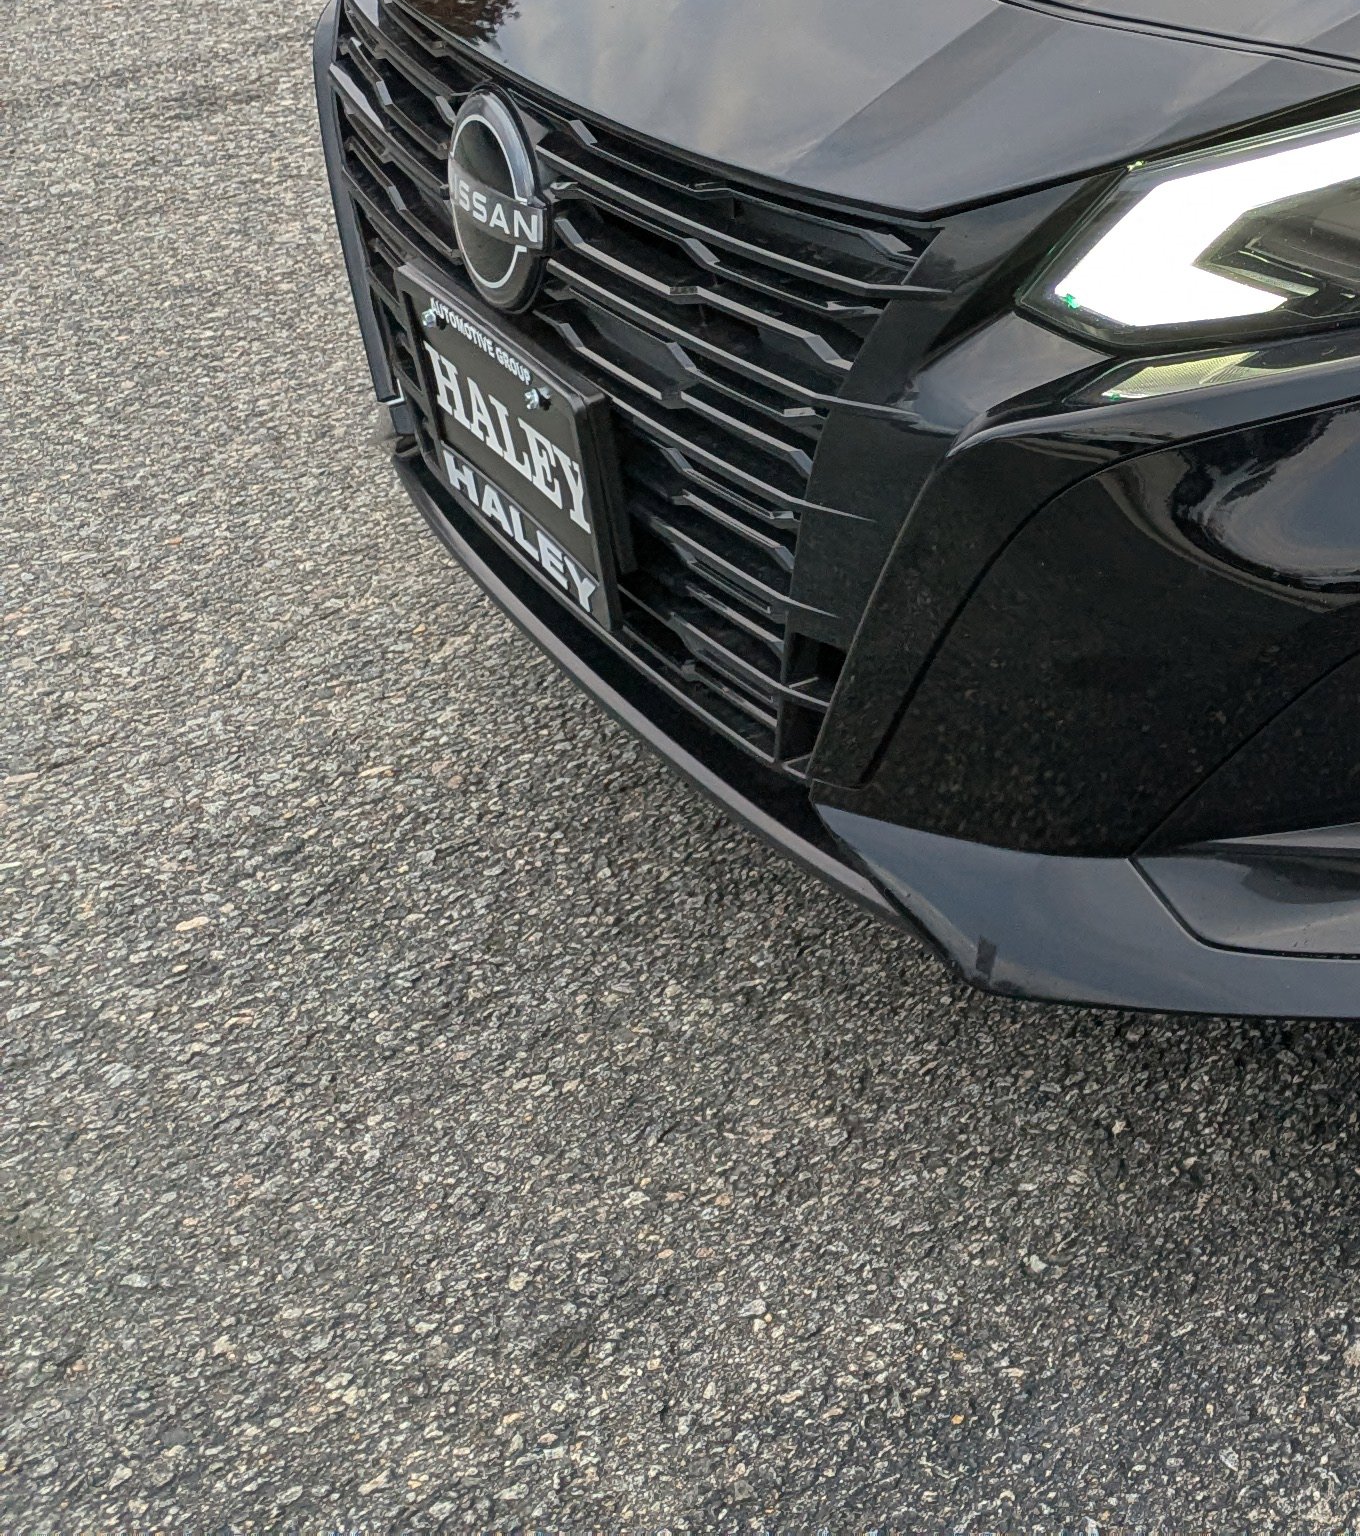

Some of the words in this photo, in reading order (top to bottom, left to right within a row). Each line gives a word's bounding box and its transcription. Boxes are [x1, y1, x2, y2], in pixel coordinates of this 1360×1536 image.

[450, 170, 539, 244] ISSAN
[430, 297, 495, 359] AUTOMOTIVE
[494, 346, 532, 386] GROUP
[423, 340, 592, 535] HALEY
[443, 449, 597, 613] HALEY
